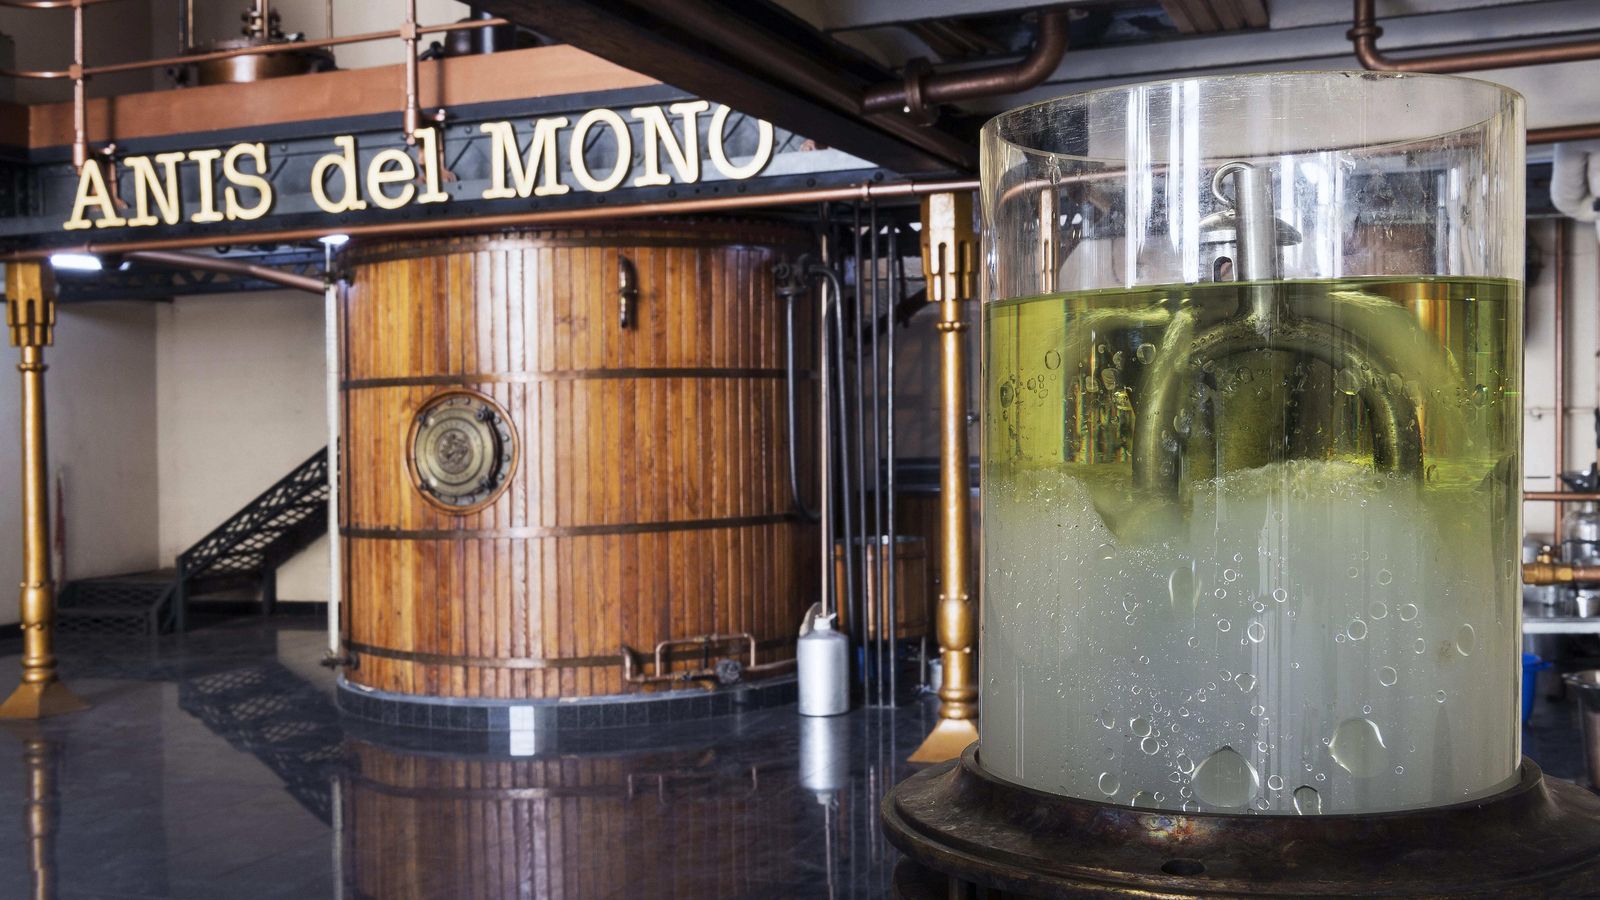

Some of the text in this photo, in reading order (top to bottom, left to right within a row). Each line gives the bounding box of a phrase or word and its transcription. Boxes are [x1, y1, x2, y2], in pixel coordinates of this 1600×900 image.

[63, 100, 774, 229] ANIS del MONO
